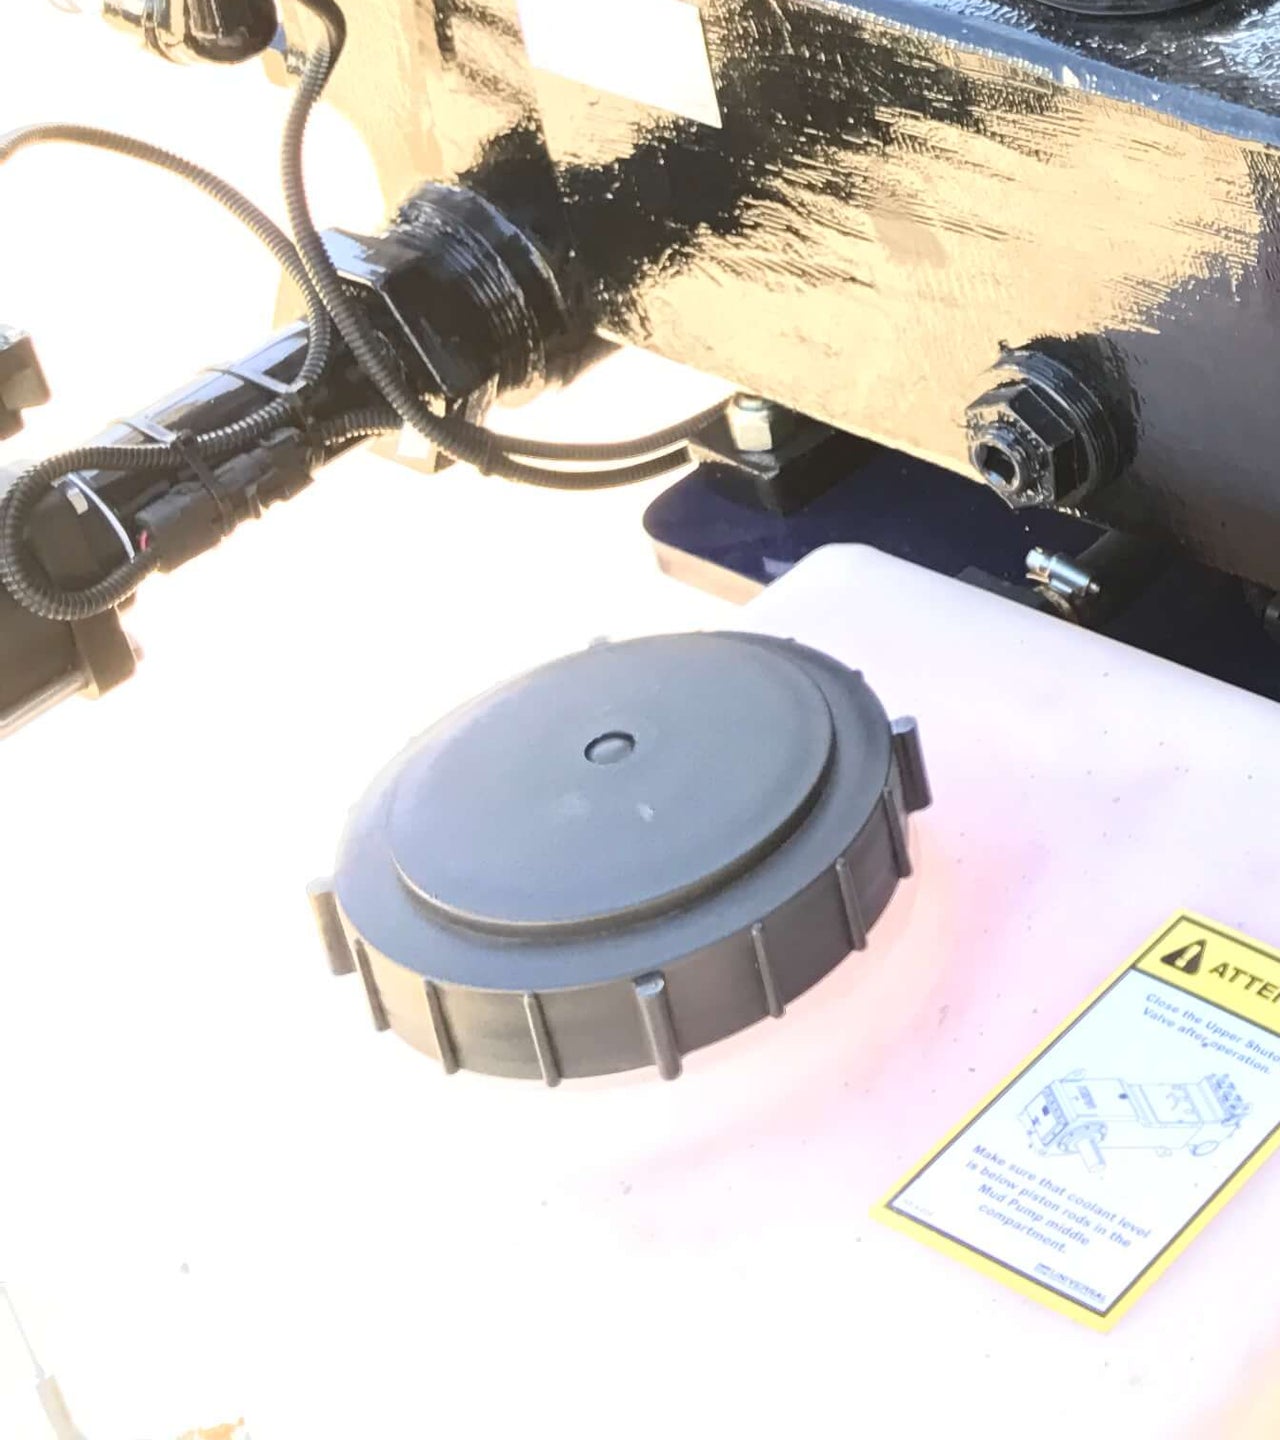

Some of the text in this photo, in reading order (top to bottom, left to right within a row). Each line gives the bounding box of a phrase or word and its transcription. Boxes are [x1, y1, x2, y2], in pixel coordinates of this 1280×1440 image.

[1142, 1007, 1272, 1074] Valve after operation.
[1145, 993, 1179, 1012] Close
[1182, 1009, 1202, 1023] the
[1206, 1022, 1243, 1042] Upper
[966, 1160, 1131, 1247] is below piston rods in the
[972, 1144, 1151, 1238] Make sure that coolant level
[978, 1184, 1090, 1244] Mud Pump middle
[978, 1205, 1067, 1253] compartment.
